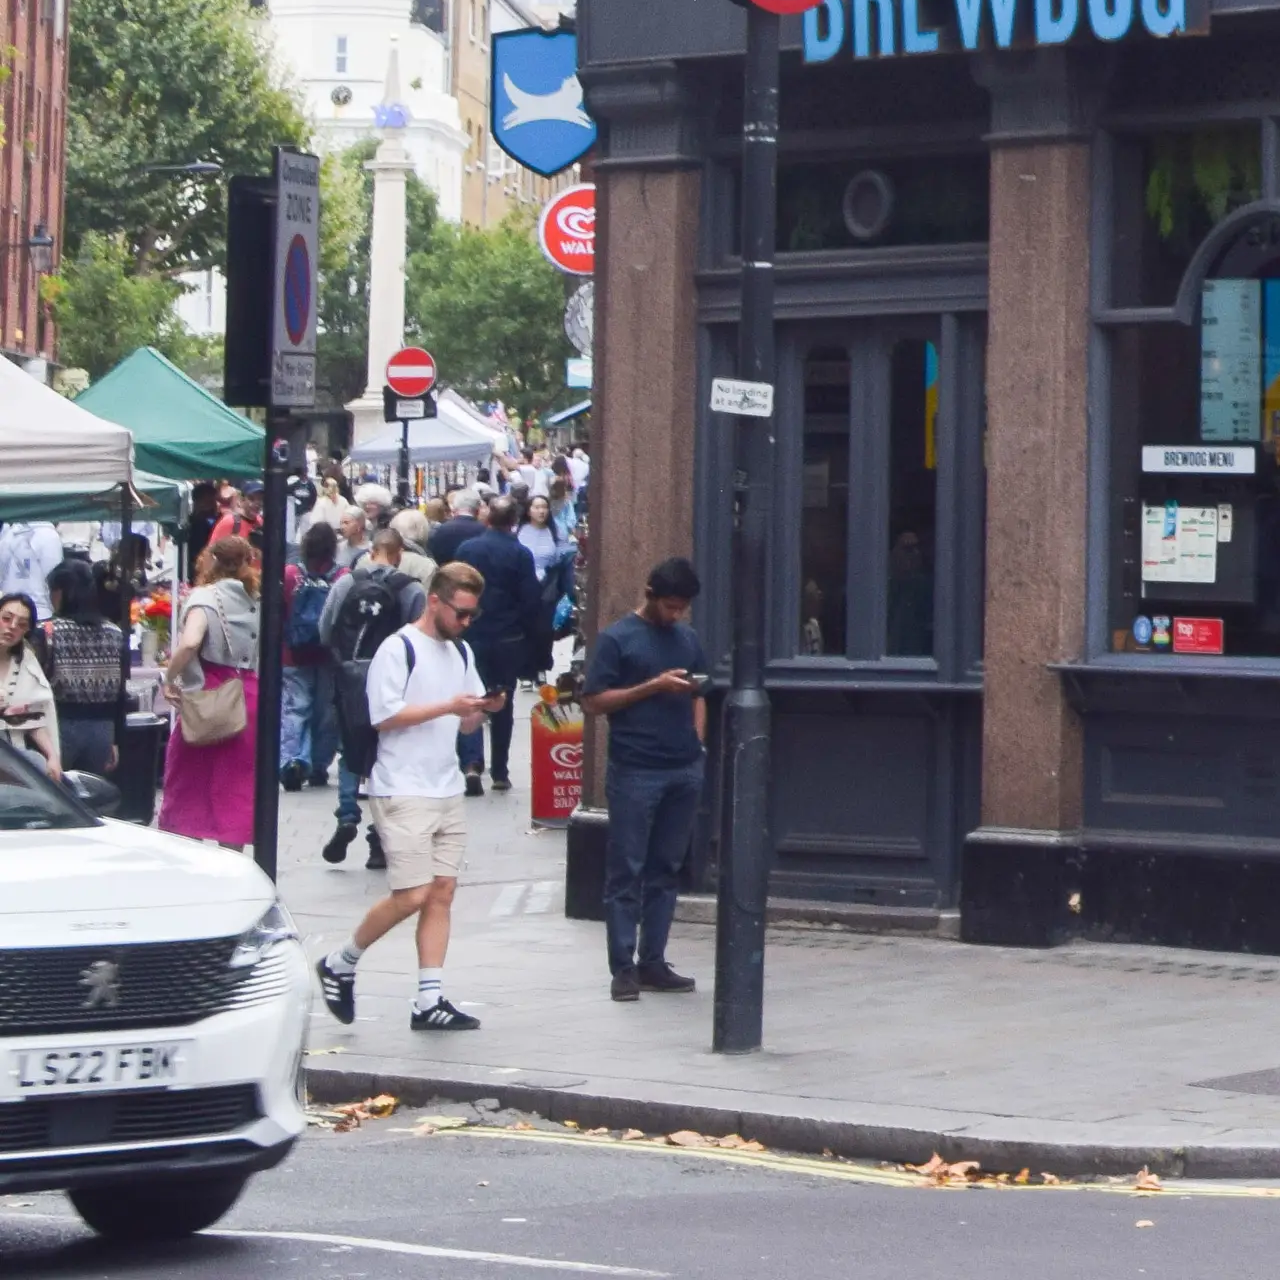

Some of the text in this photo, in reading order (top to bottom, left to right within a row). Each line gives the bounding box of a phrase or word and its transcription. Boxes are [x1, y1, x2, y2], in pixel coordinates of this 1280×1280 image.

[560, 240, 595, 255] WAL
[1164, 451, 1235, 467] BREWDOG MENU
[553, 770, 583, 780] WAL
[18, 1048, 107, 1087] LS22
